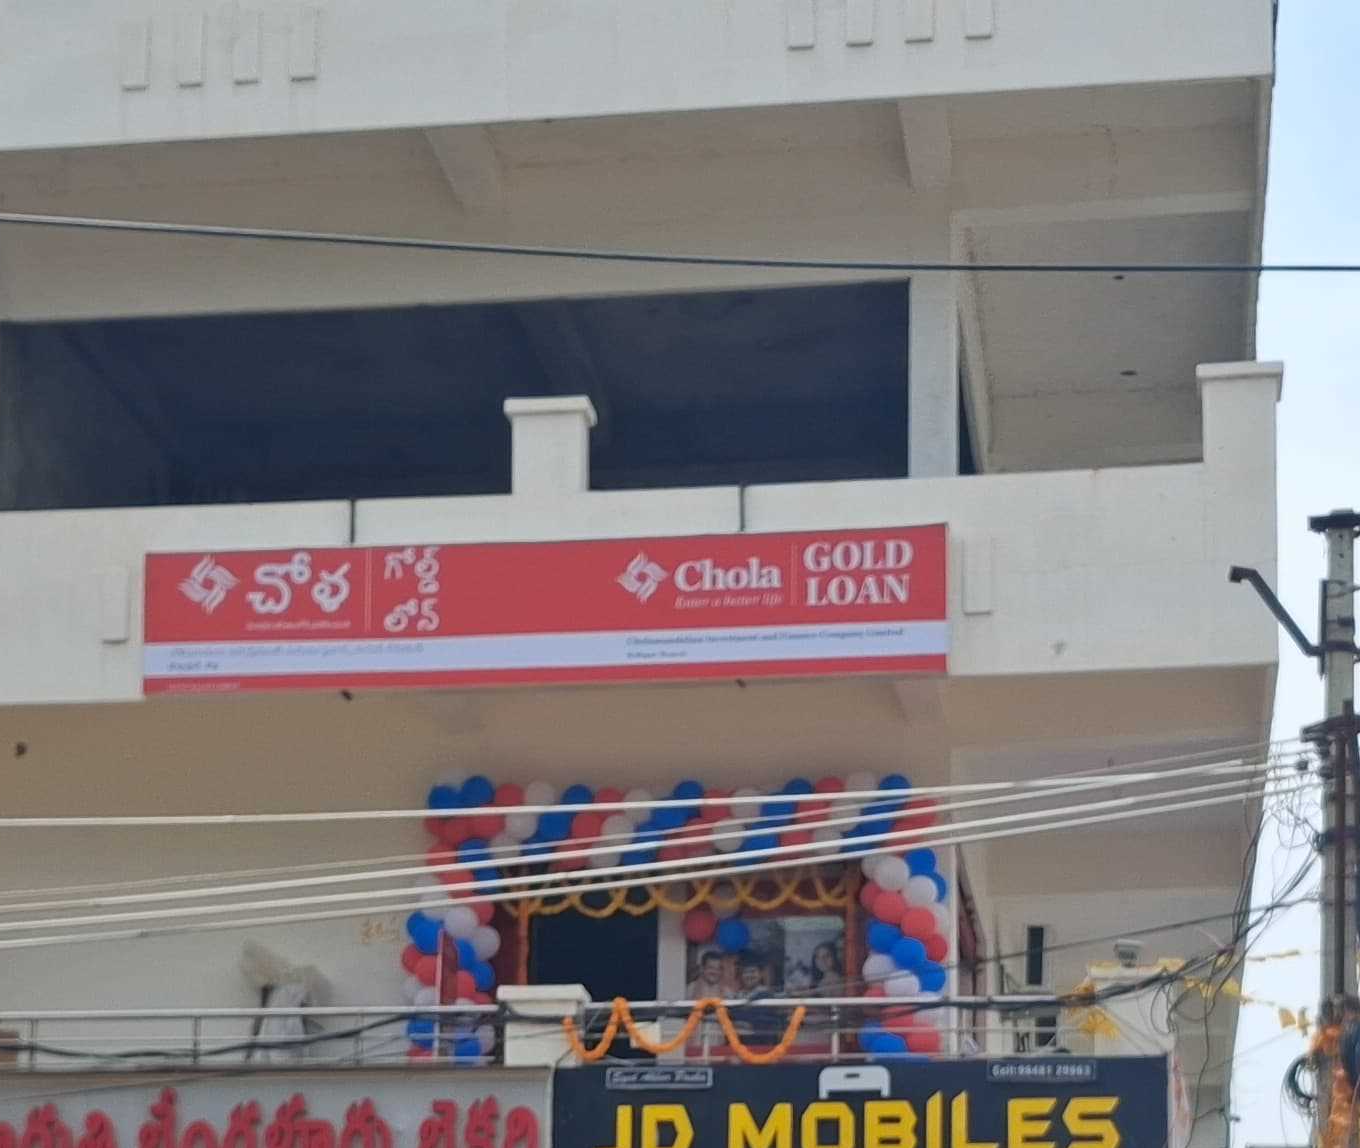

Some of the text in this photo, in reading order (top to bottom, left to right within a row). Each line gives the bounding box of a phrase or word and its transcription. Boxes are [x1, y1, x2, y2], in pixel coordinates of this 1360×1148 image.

[803, 540, 914, 572] GOLD
[246, 551, 351, 614] చోళ
[674, 556, 782, 592] Chola
[806, 573, 911, 607] LOAN
[383, 598, 440, 633] లోన్
